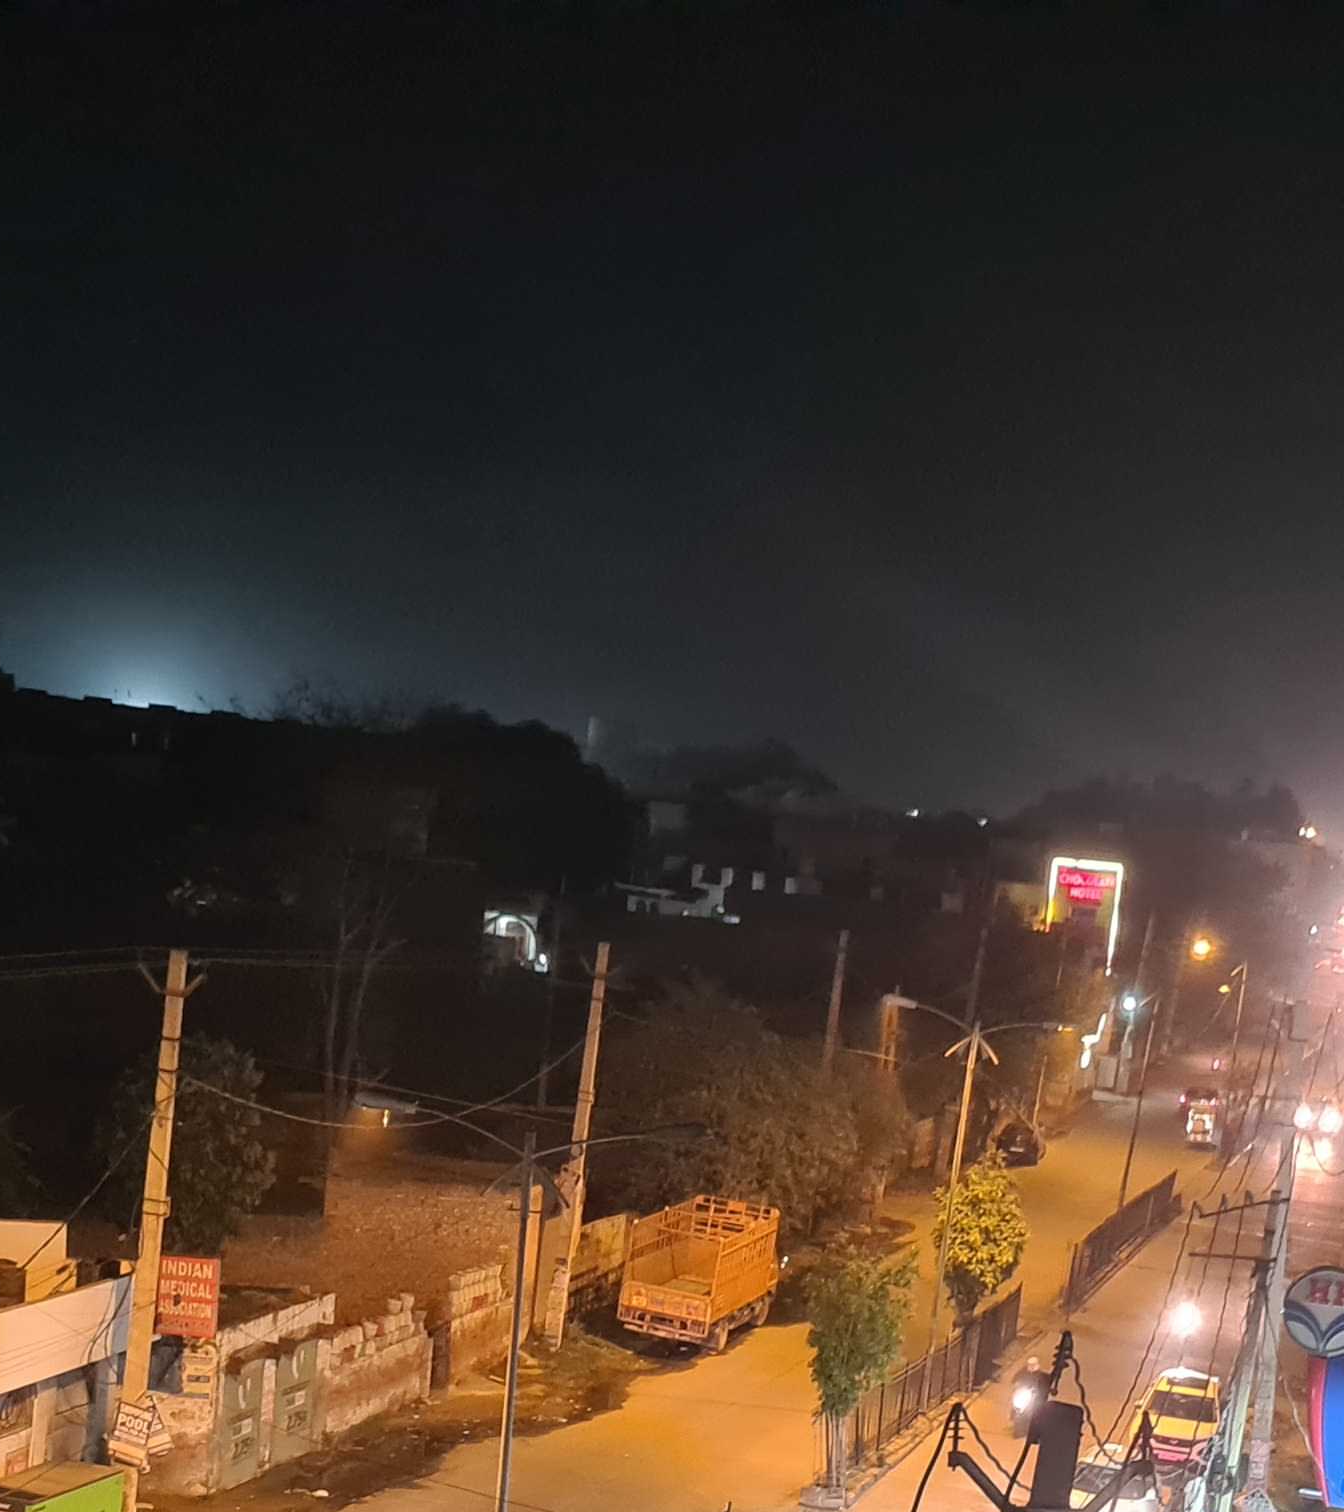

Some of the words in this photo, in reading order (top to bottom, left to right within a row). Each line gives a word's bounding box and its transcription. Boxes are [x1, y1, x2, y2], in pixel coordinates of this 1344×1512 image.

[162, 1259, 213, 1279] INDIAN
[160, 1279, 213, 1299] MEDICAL
[116, 1412, 149, 1434] POOL
